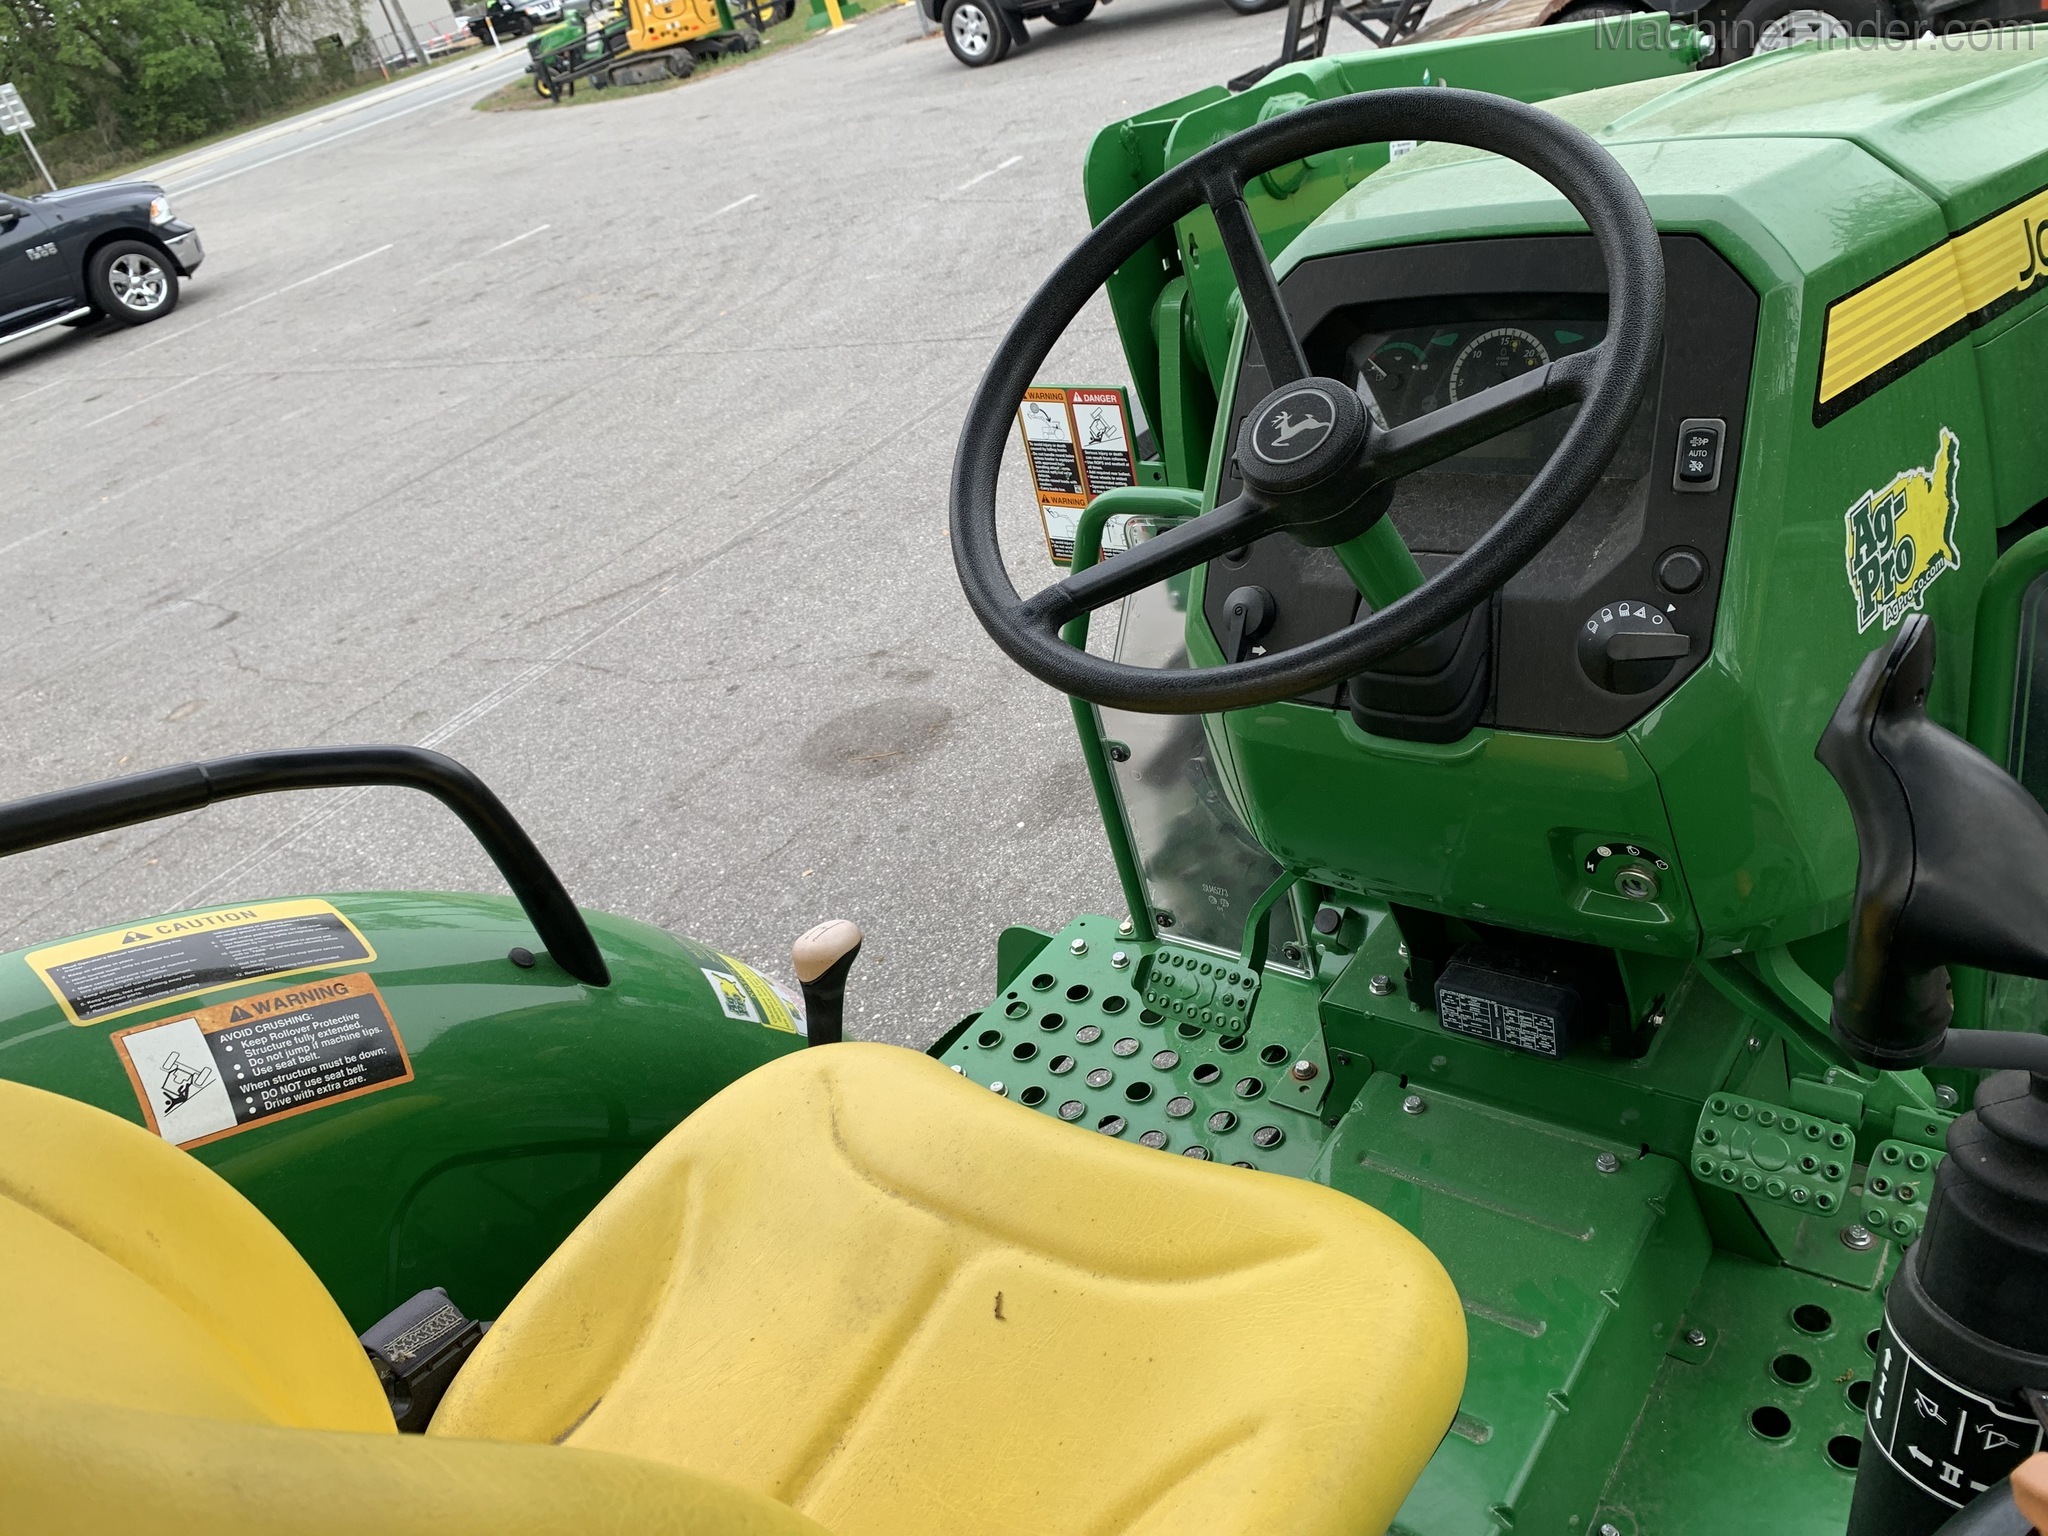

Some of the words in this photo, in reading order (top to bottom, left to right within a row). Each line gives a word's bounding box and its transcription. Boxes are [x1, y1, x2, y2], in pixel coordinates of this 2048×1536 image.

[1500, 337, 1510, 345] 15
[1523, 349, 1535, 357] 20
[1027, 391, 1064, 400] WARNING
[1083, 394, 1117, 403] DANGER
[1050, 497, 1086, 506] WARNING
[1856, 535, 1916, 629] Pro
[1885, 557, 1945, 626] AgProCo.com
[155, 909, 258, 936] CAUTION
[251, 982, 350, 1015] WARNING
[219, 1029, 253, 1044] AVOID
[255, 1012, 315, 1034] CRUSHING:
[241, 1036, 267, 1048] Keep
[269, 1024, 311, 1040] Rollover
[312, 1012, 359, 1028] Protective
[244, 1038, 292, 1057] Structure
[294, 1033, 315, 1044] fully
[317, 1020, 363, 1037] extended.
[249, 1057, 263, 1065] Do
[266, 1052, 282, 1061] not
[285, 1045, 310, 1057] jump
[320, 1031, 360, 1046] machine
[362, 1025, 382, 1036] tips.
[239, 1079, 269, 1092] When
[271, 1065, 317, 1083] structure
[318, 1058, 343, 1070] must
[344, 1054, 357, 1063] be
[358, 1046, 387, 1060] down;
[252, 1064, 272, 1075] Use
[275, 1058, 296, 1069] seat
[298, 1051, 320, 1062] belt.
[261, 1088, 277, 1099] DO
[280, 1081, 301, 1093] NOT
[304, 1077, 322, 1086] use
[324, 1070, 344, 1080] seat
[346, 1063, 367, 1074] belt.
[264, 1096, 291, 1109] Drive
[293, 1089, 314, 1100] with
[316, 1082, 340, 1094] extra
[342, 1075, 366, 1086] care.
